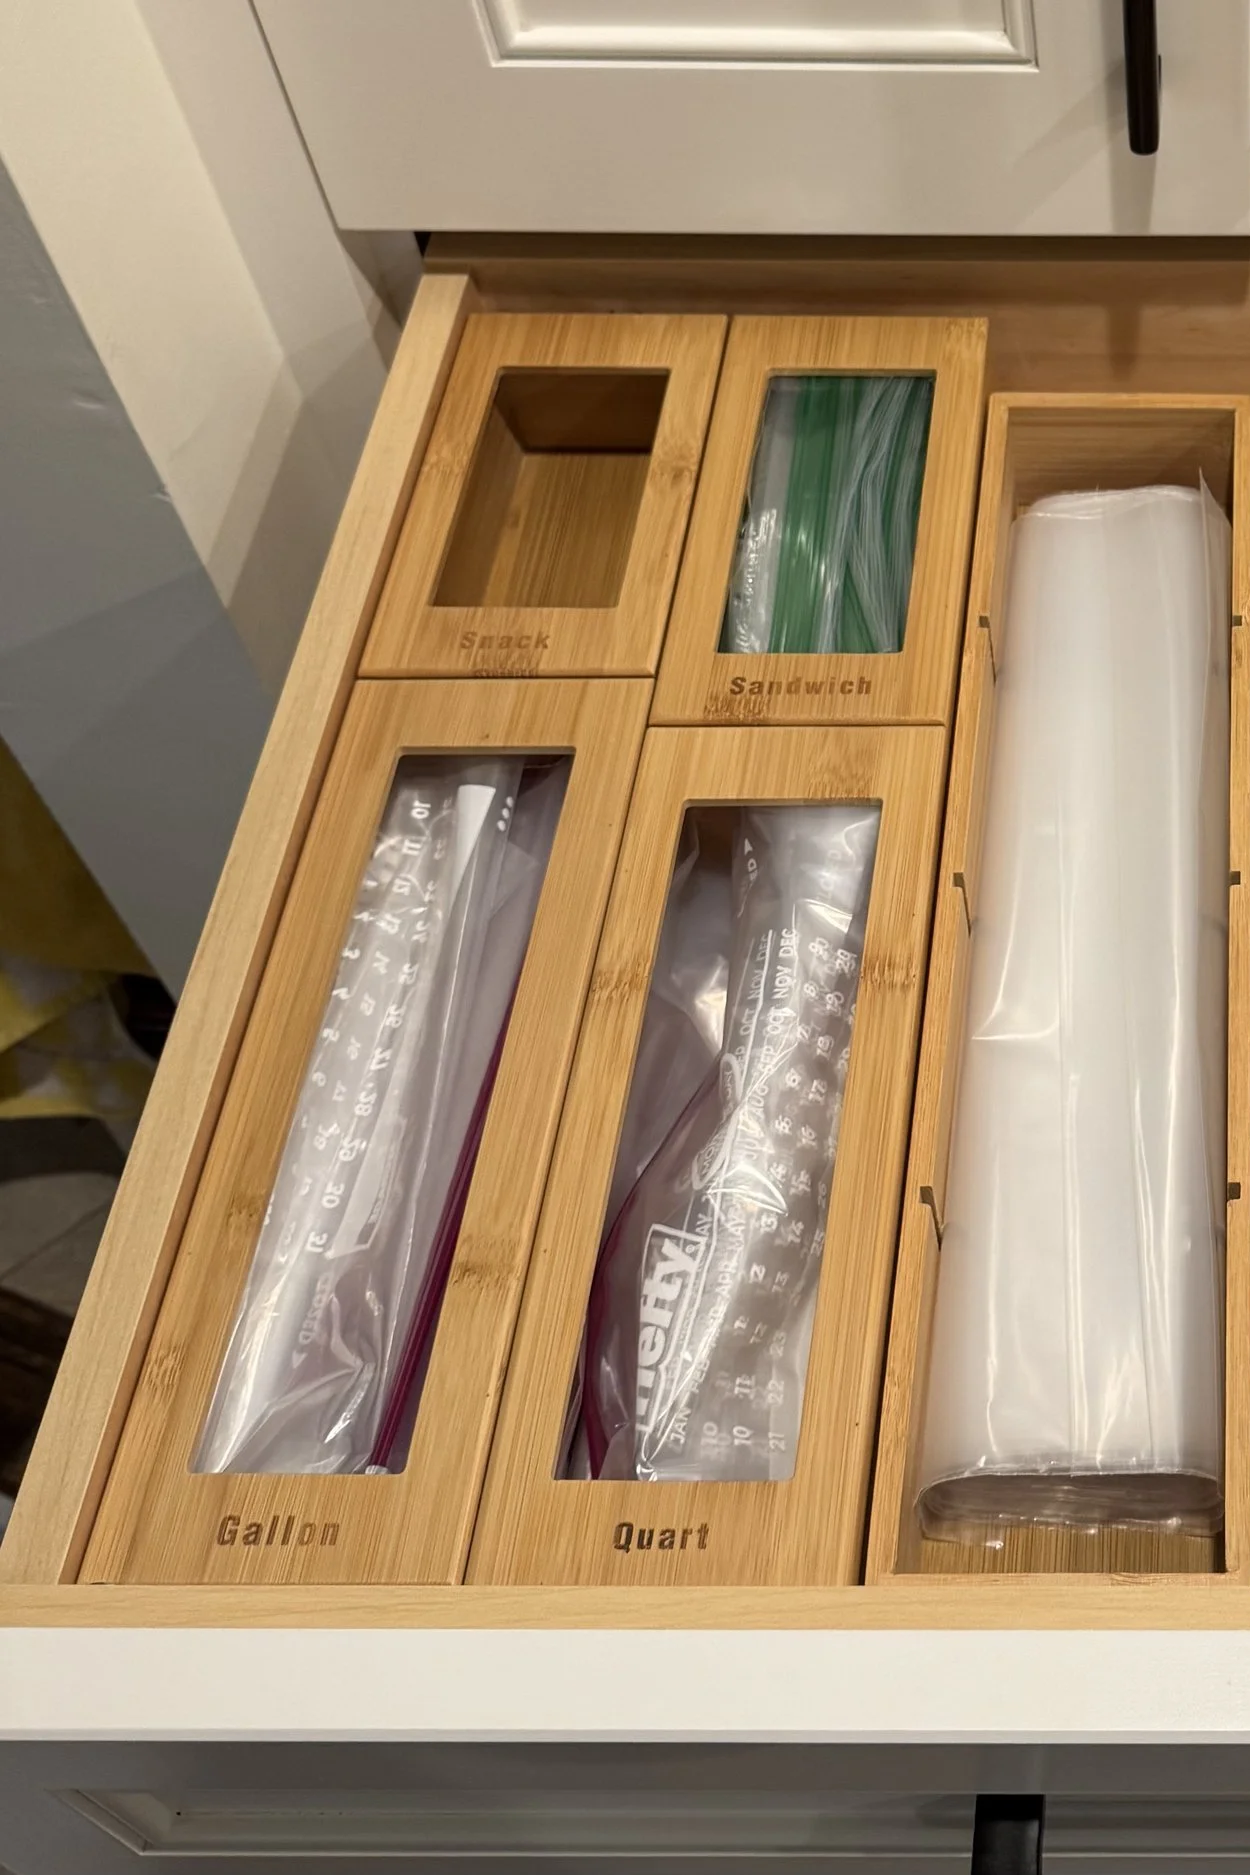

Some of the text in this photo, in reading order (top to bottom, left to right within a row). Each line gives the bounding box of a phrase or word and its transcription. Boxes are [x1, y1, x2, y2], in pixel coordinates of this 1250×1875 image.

[460, 630, 550, 650] Snack
[729, 676, 872, 696] Sandwich
[778, 928, 796, 958] DEC
[772, 965, 793, 999] NOV
[670, 1407, 691, 1444] JAN
[216, 1515, 341, 1547] Gallon
[612, 1521, 710, 1553] Quart
